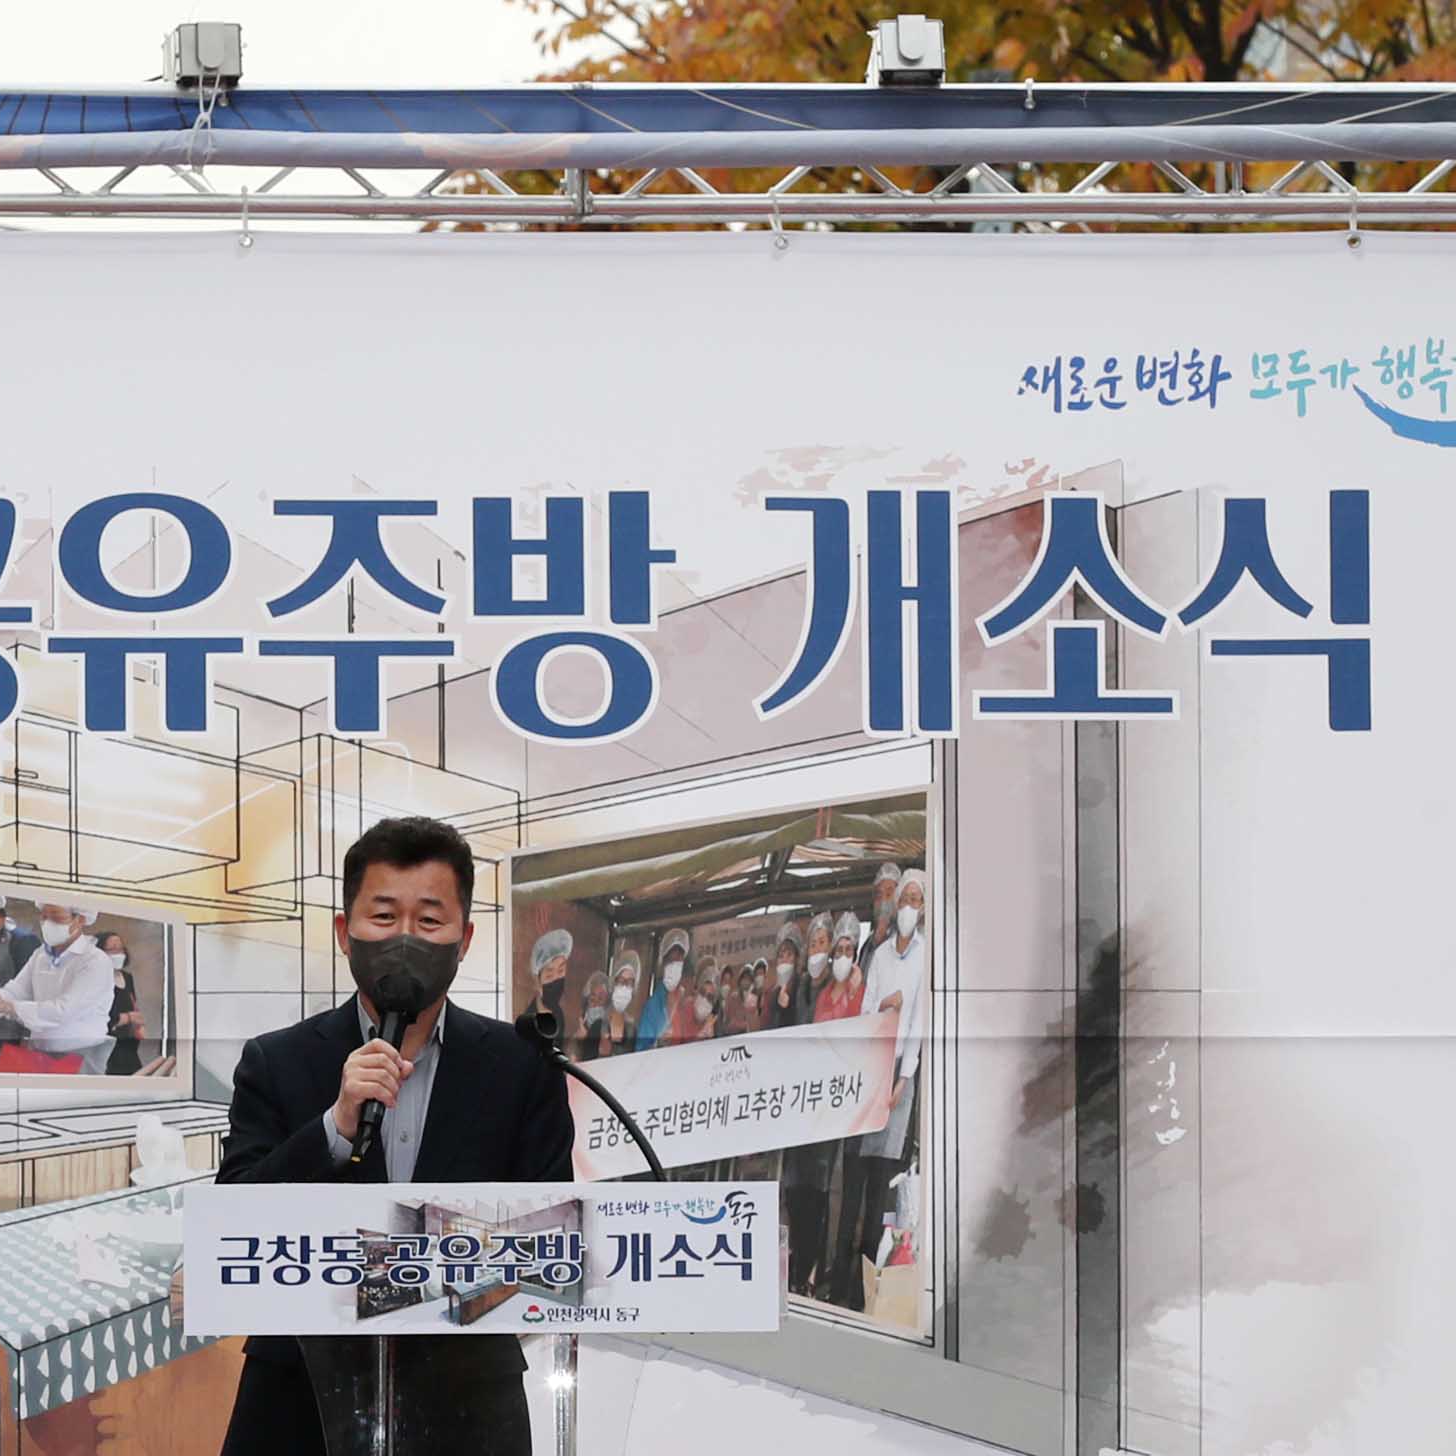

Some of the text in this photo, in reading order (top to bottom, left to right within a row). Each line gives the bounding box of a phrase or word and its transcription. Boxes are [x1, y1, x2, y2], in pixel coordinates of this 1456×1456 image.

[1018, 354, 1126, 413] 새로운
[1136, 347, 1233, 409] 변화
[1249, 350, 1355, 417] 모두가
[759, 489, 1373, 732] 개소식
[645, 1094, 730, 1140] 주민협의체
[733, 1085, 784, 1121] 고추장
[791, 1079, 823, 1113] 기부
[829, 1071, 862, 1108] 행사
[216, 1230, 753, 1288] 금창동 공유주방 개소식
[547, 1306, 640, 1322] 인천광역시 동구
